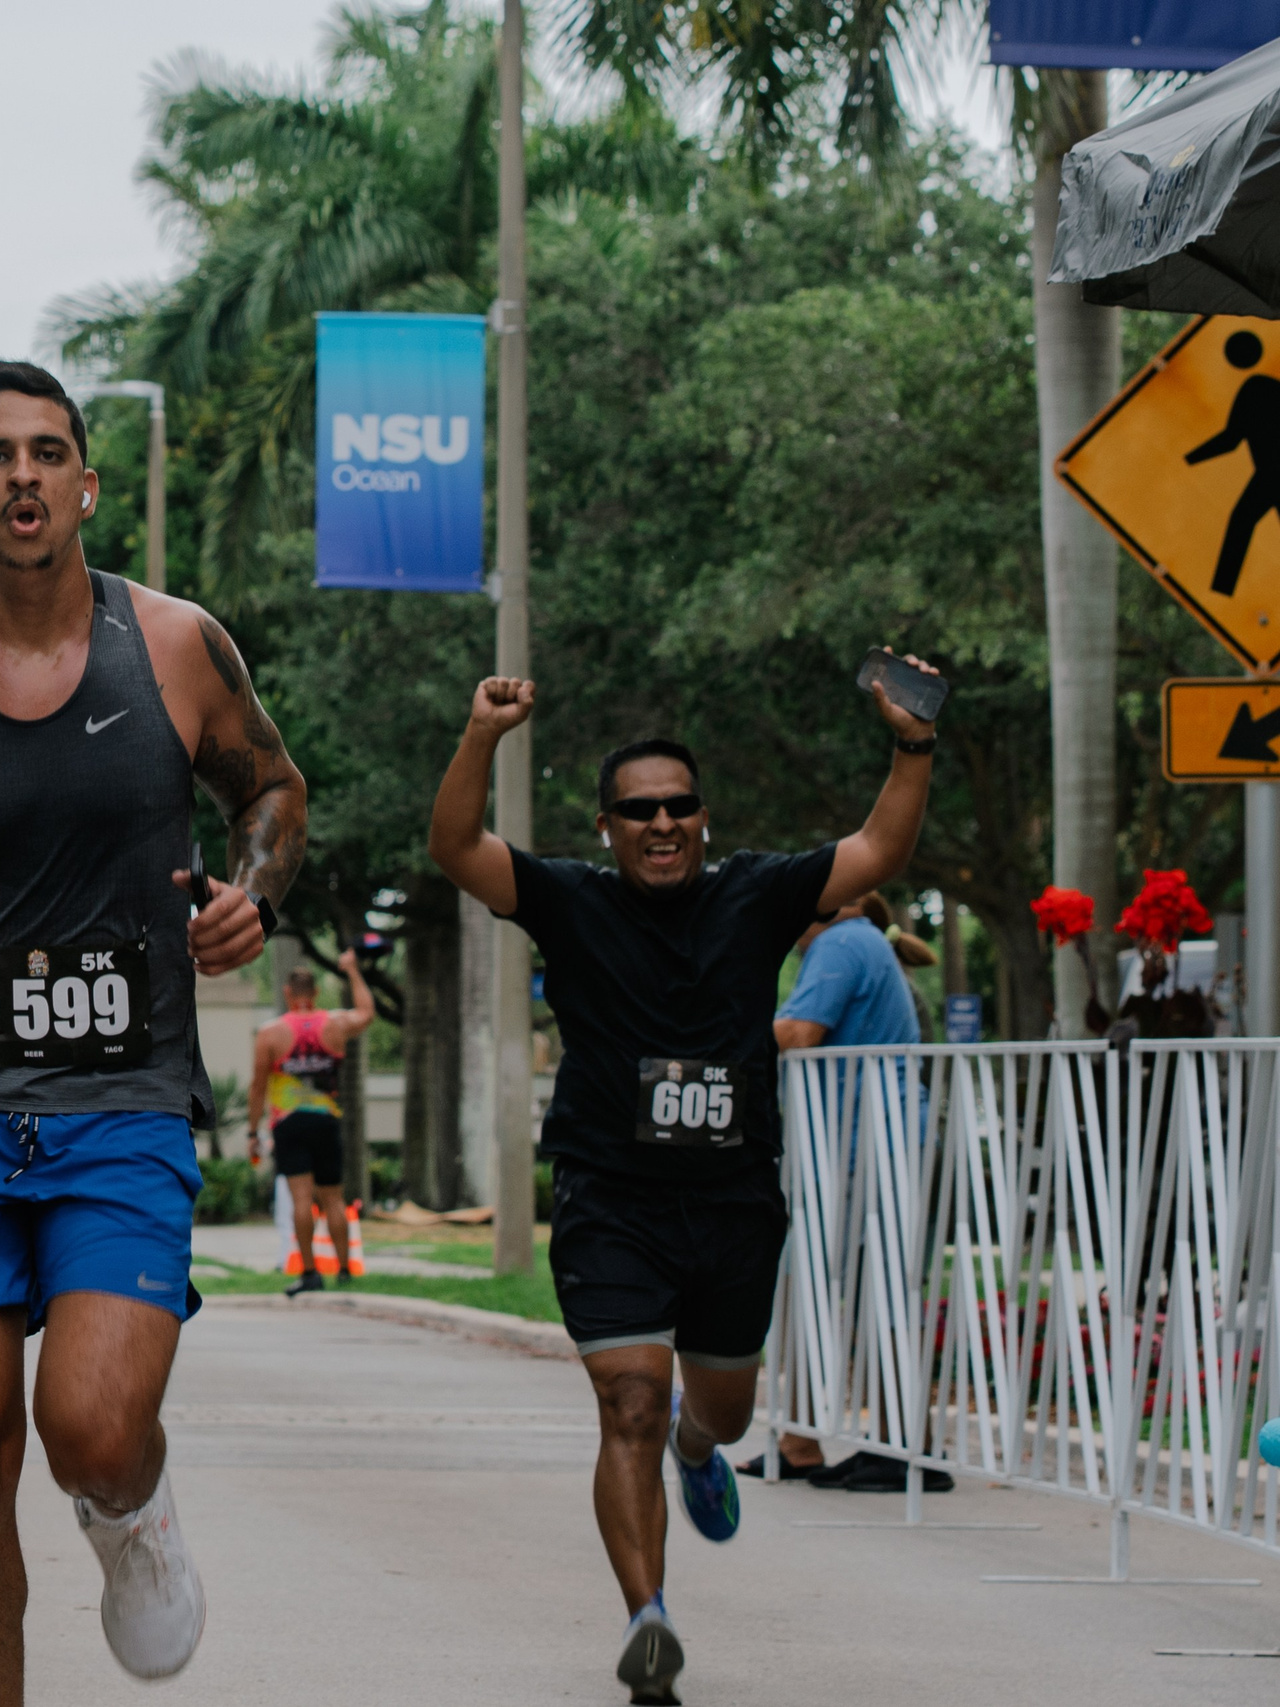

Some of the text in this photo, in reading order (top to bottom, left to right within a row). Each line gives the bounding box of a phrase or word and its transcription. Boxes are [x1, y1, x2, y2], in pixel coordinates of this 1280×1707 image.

[332, 413, 469, 465] NSU
[331, 463, 421, 492] Ocean
[81, 951, 115, 972] 5K
[12, 973, 130, 1041] 599
[24, 1045, 124, 1058] BEER TACO
[703, 1066, 728, 1082] 5K
[651, 1080, 733, 1130] 605
